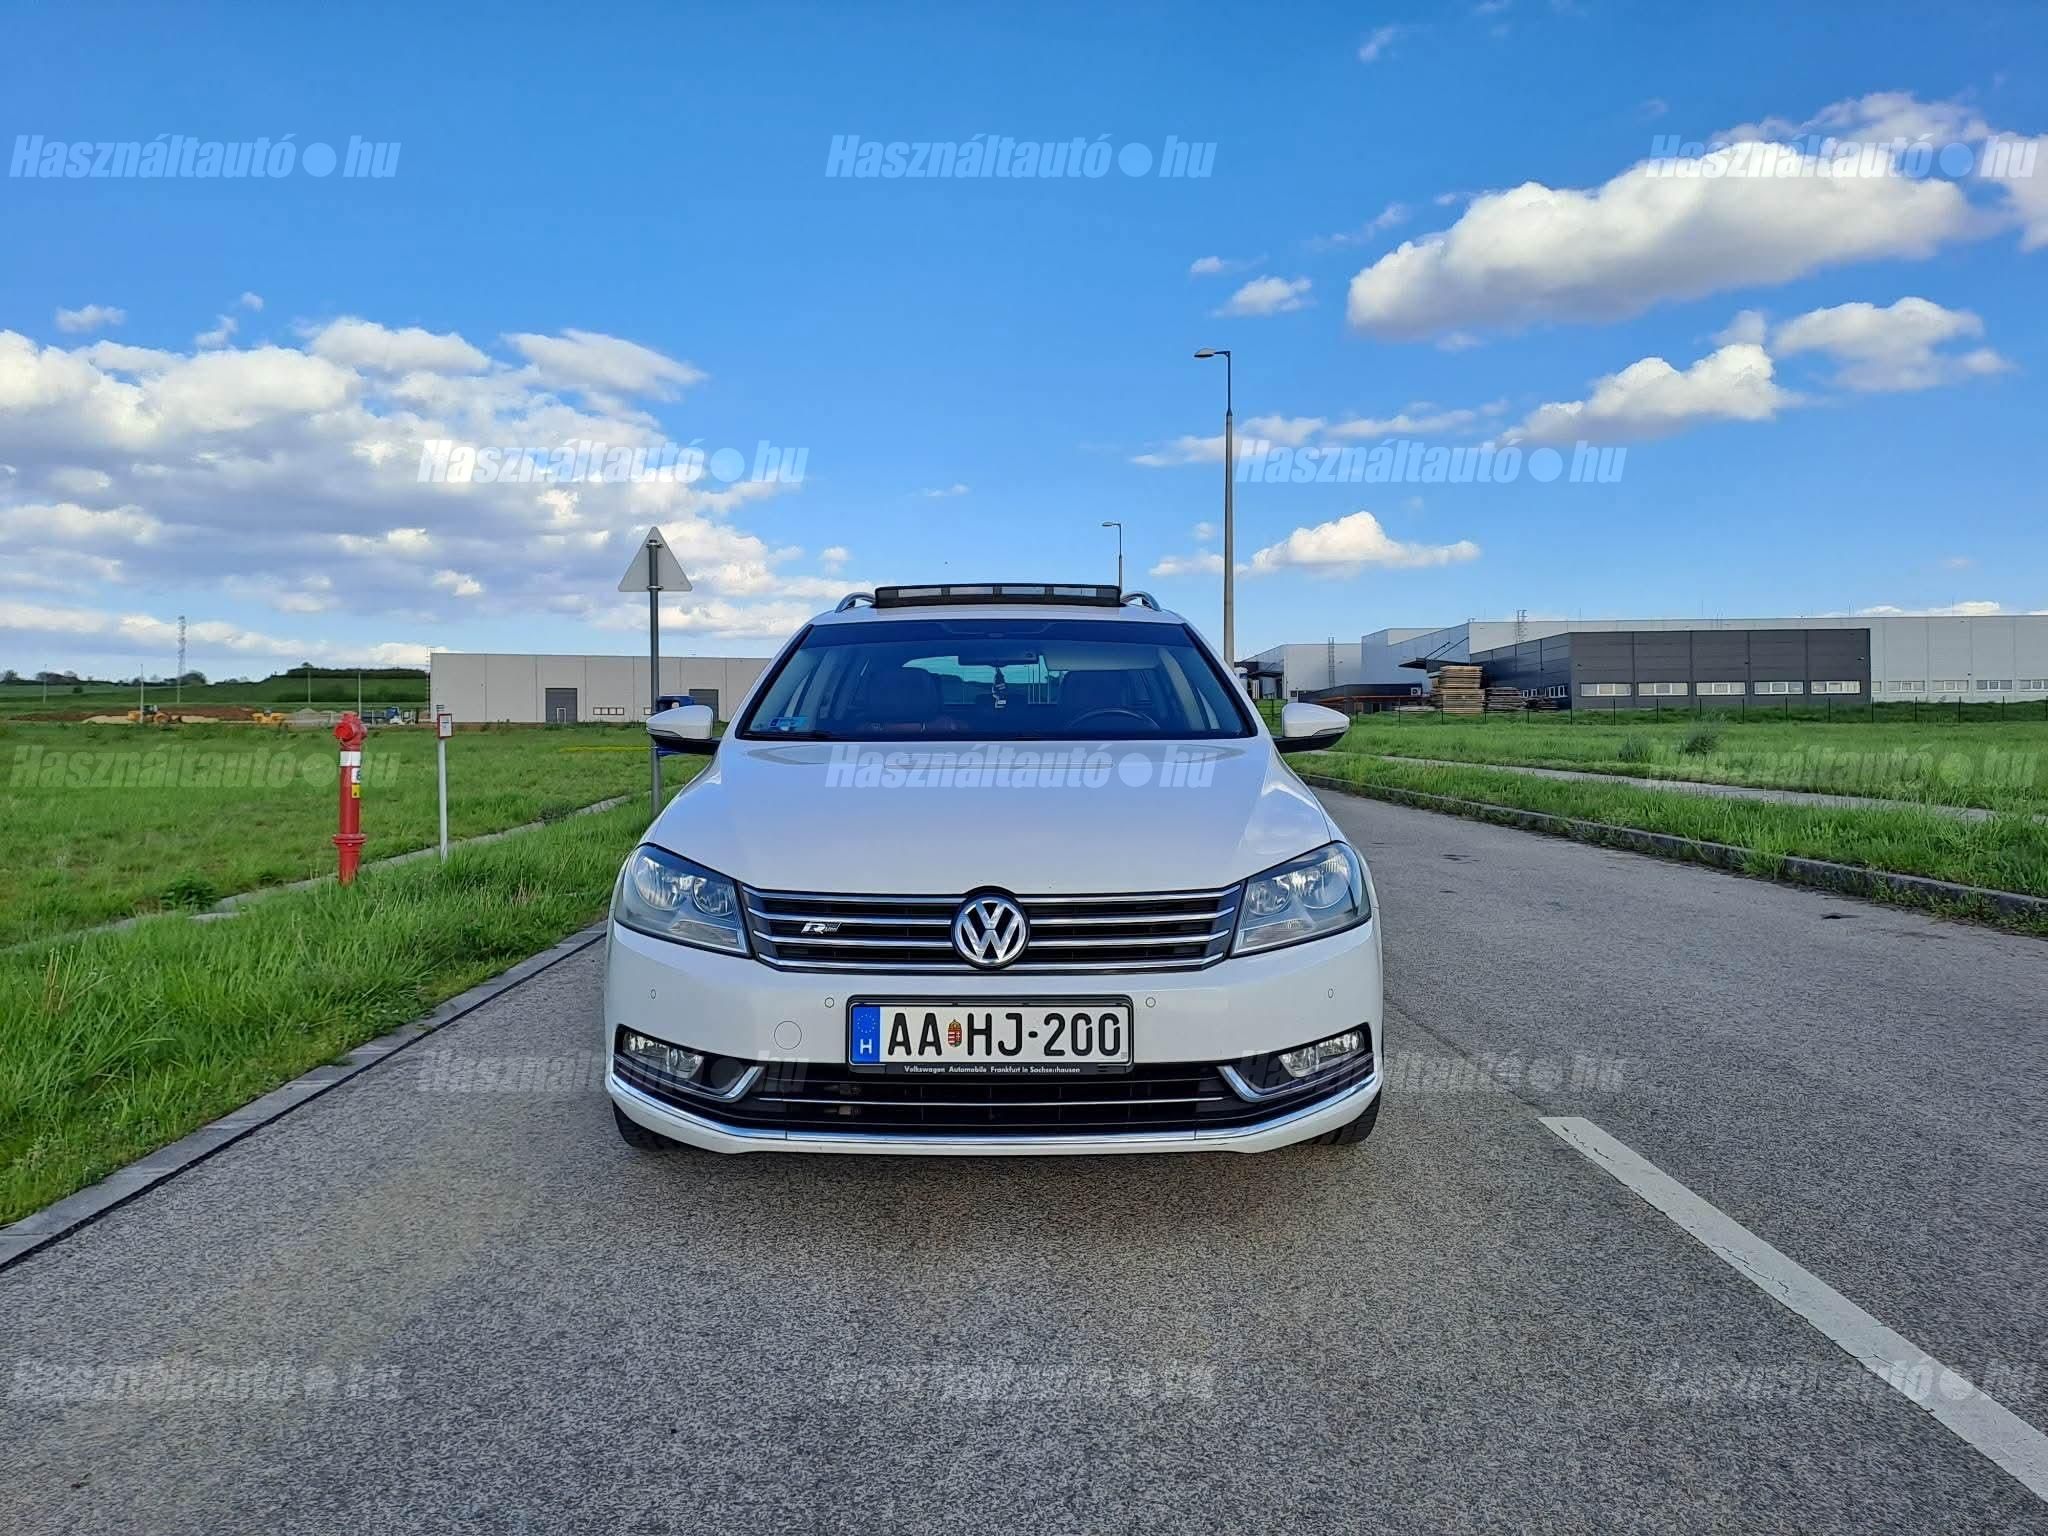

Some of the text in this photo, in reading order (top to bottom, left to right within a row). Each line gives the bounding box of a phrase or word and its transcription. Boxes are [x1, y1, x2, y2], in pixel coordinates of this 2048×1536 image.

[859, 1038, 873, 1056] H
[904, 1065, 946, 1074] Volkswagen
[949, 1065, 987, 1073] Automobile
[990, 1065, 1021, 1073] Frankfurt
